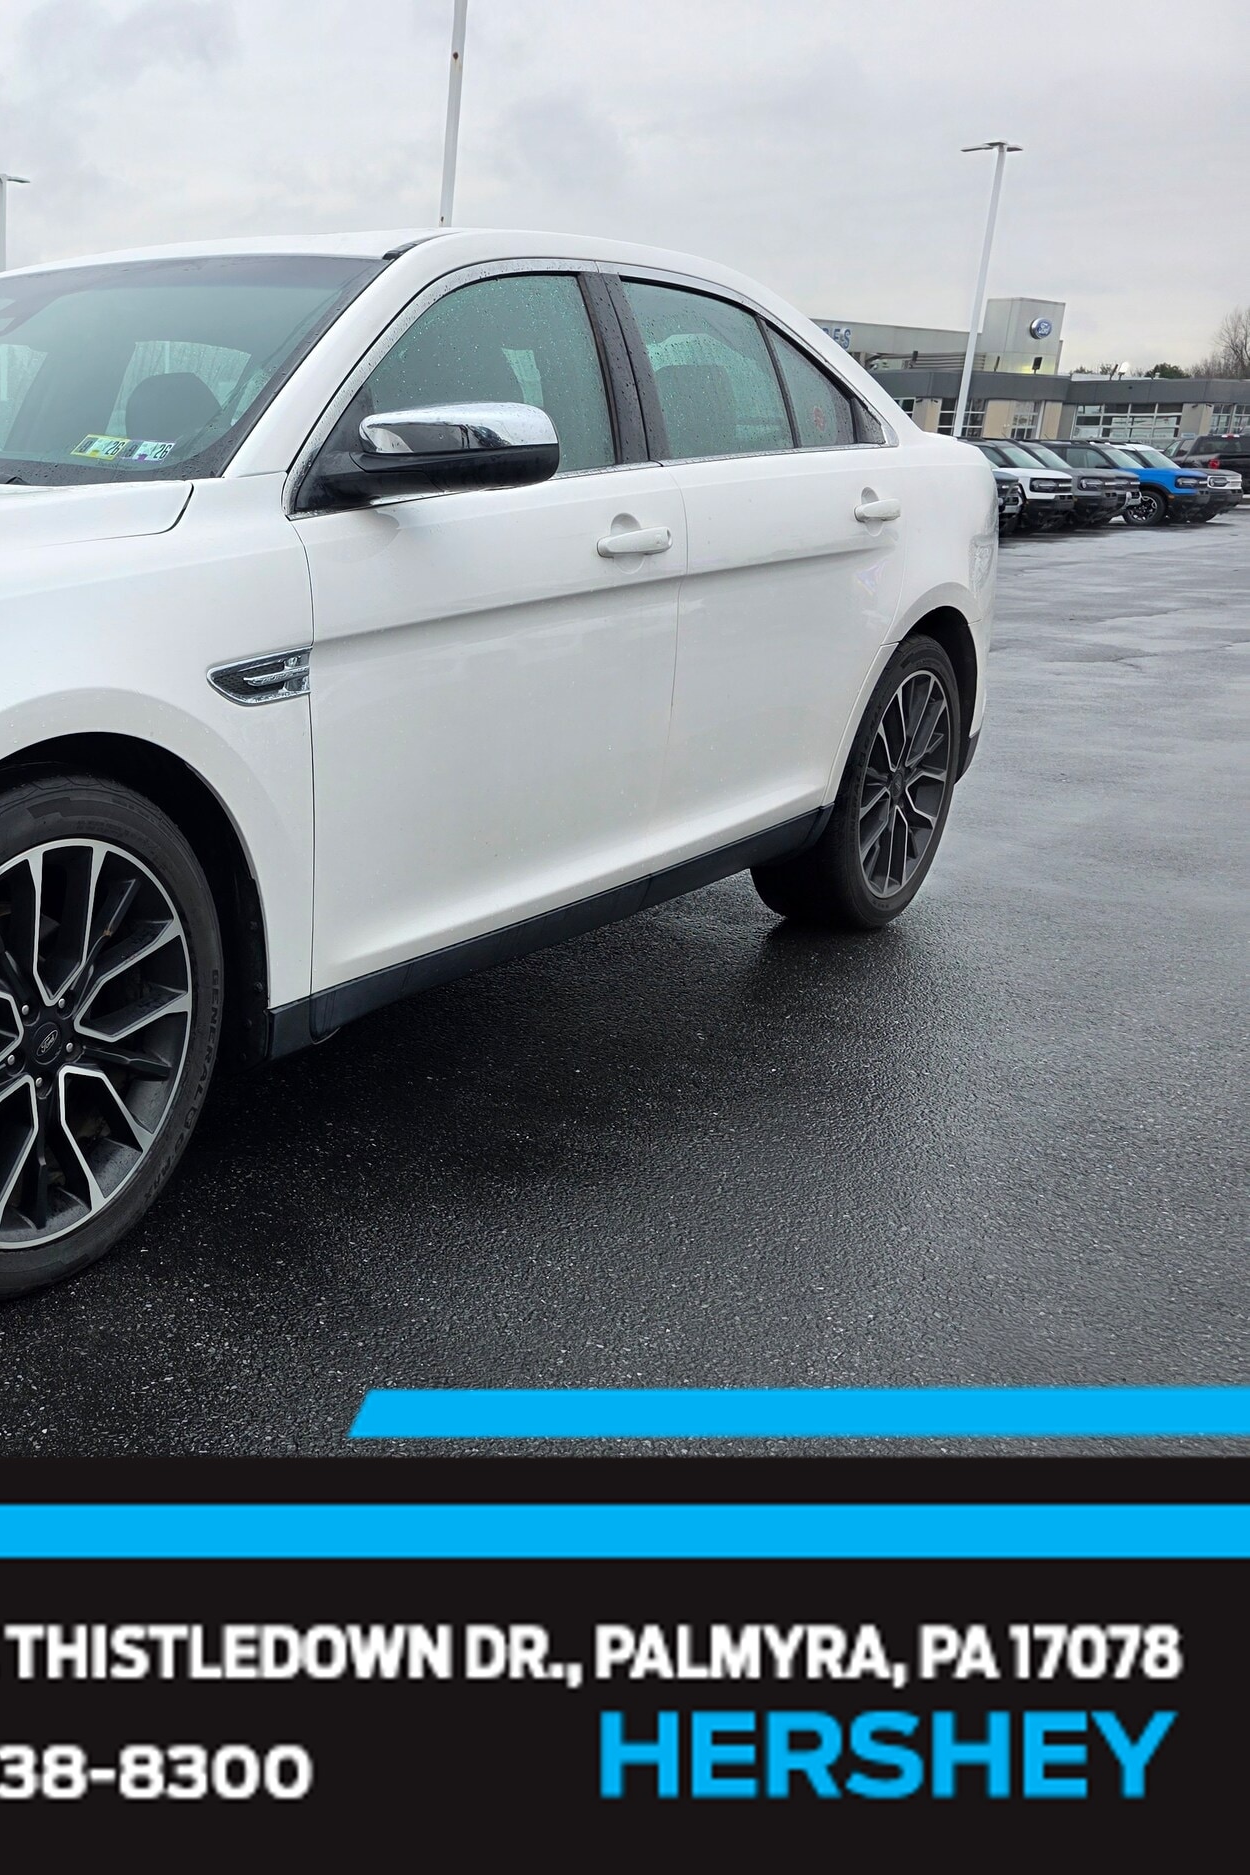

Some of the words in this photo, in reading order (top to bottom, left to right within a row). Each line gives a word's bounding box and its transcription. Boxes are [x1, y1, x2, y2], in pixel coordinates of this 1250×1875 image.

[104, 441, 126, 456] 26
[153, 444, 172, 459] 26
[194, 969, 219, 1101] GENERAL
